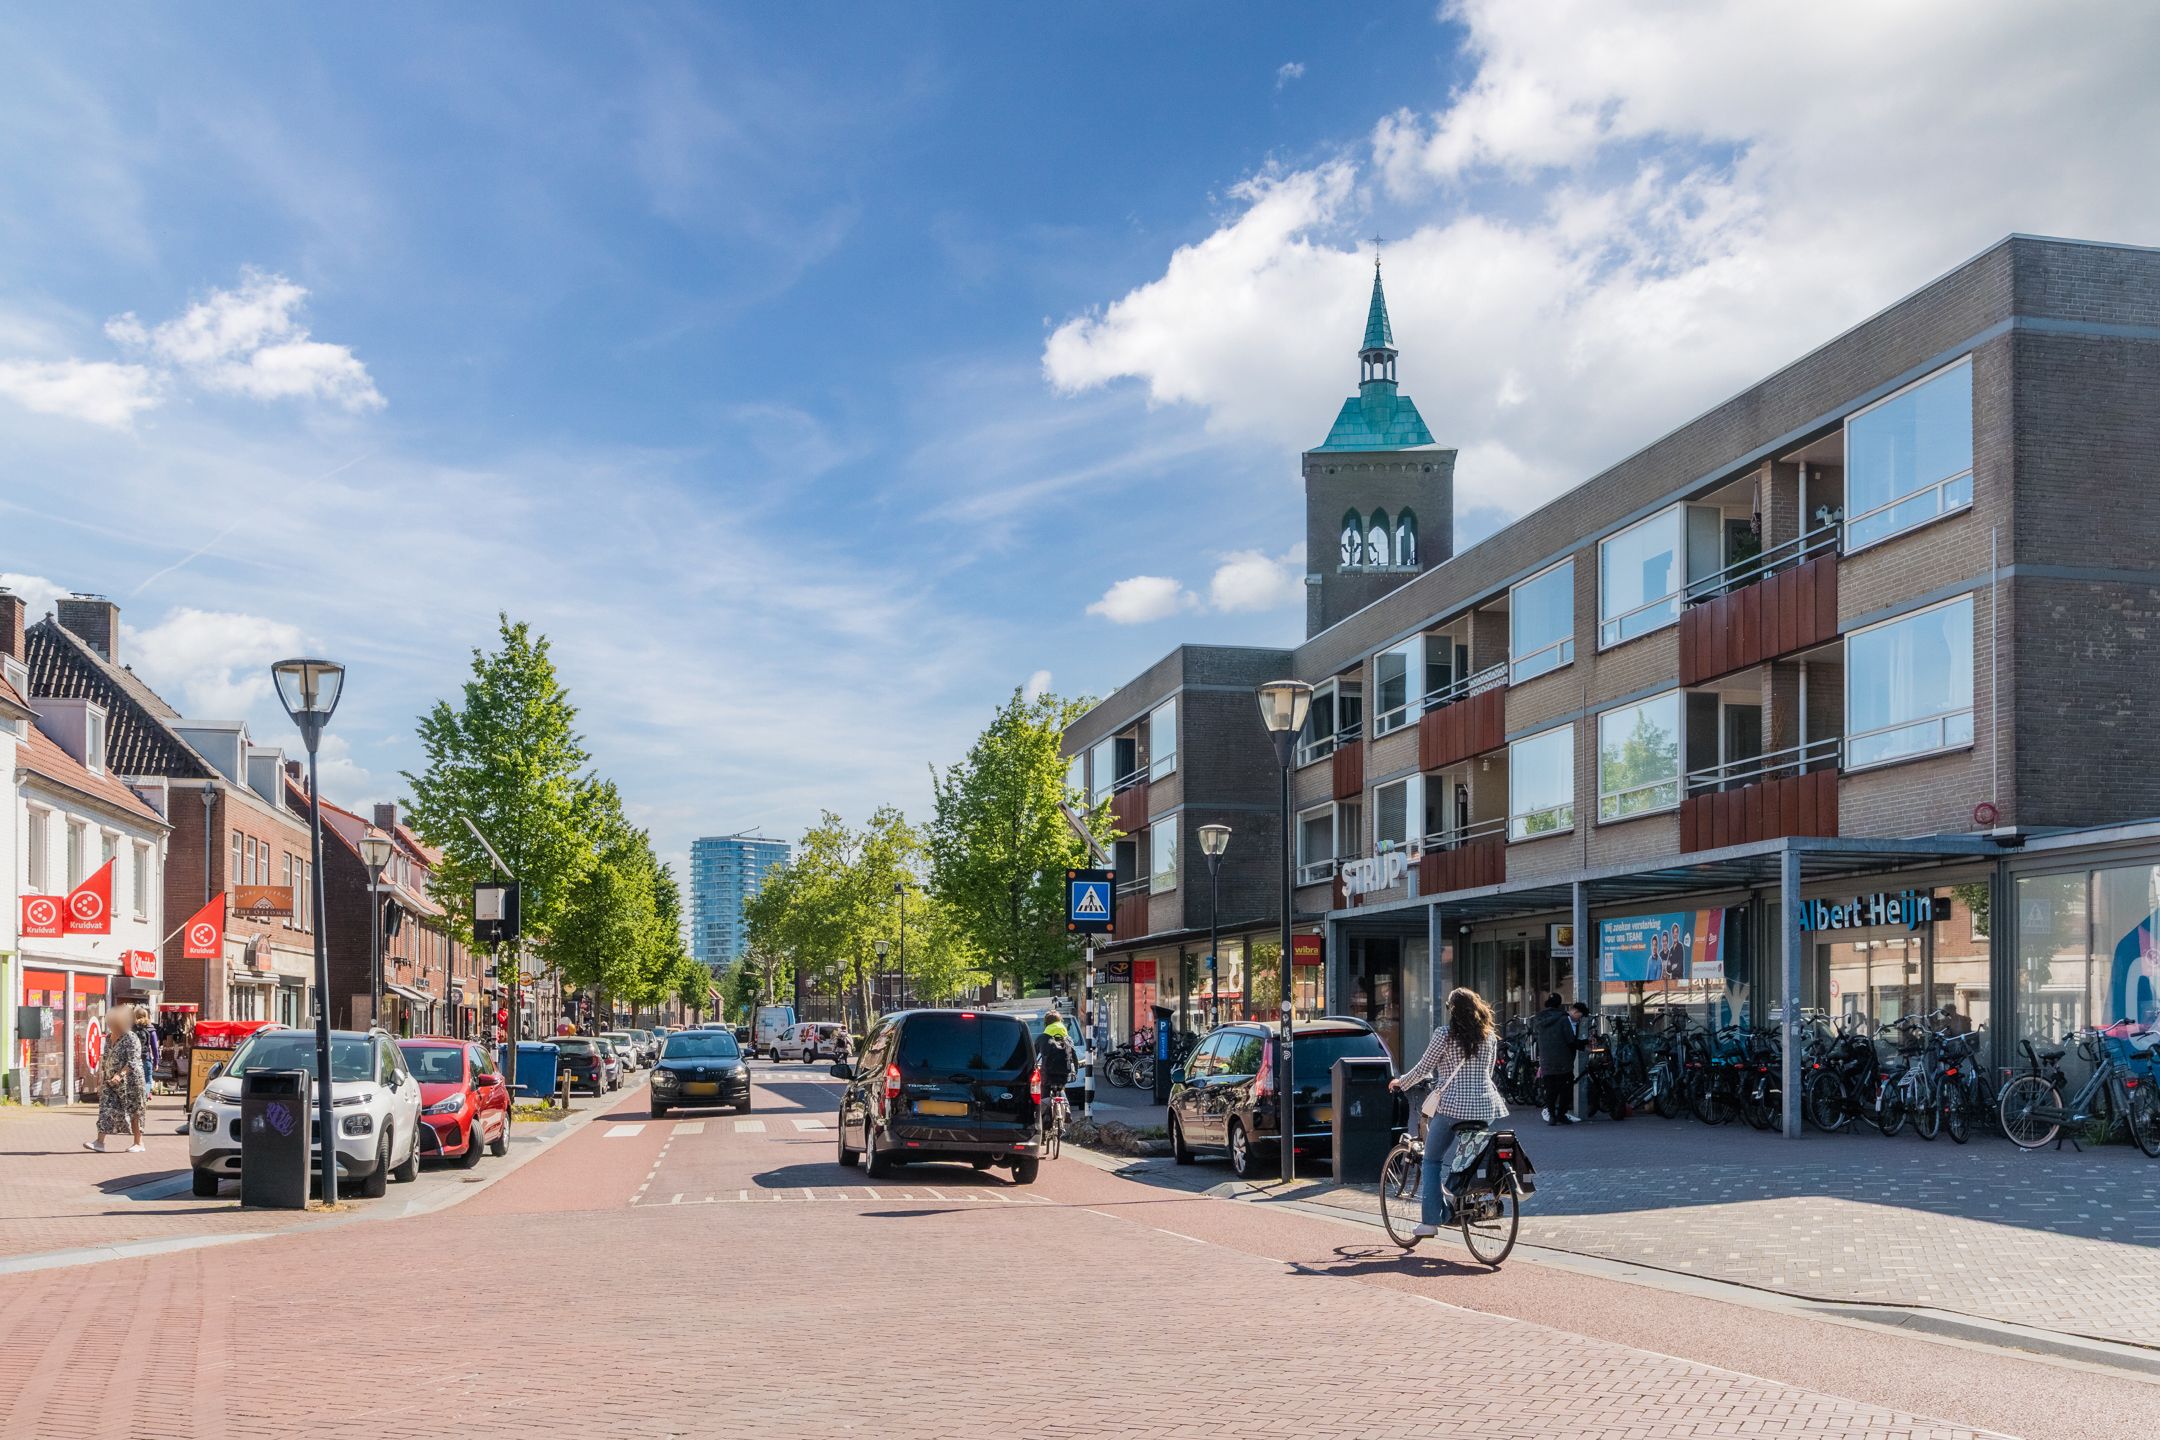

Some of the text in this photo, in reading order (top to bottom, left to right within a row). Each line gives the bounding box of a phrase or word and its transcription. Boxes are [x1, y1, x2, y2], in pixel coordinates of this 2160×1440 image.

[1342, 852, 1406, 896] STRIJP
[1800, 889, 1931, 931] Albert Heijn
[70, 921, 103, 929] Kruidvat
[26, 926, 56, 934] Kruidvat
[1294, 945, 1319, 954] wibra
[1160, 1021, 1167, 1030] P
